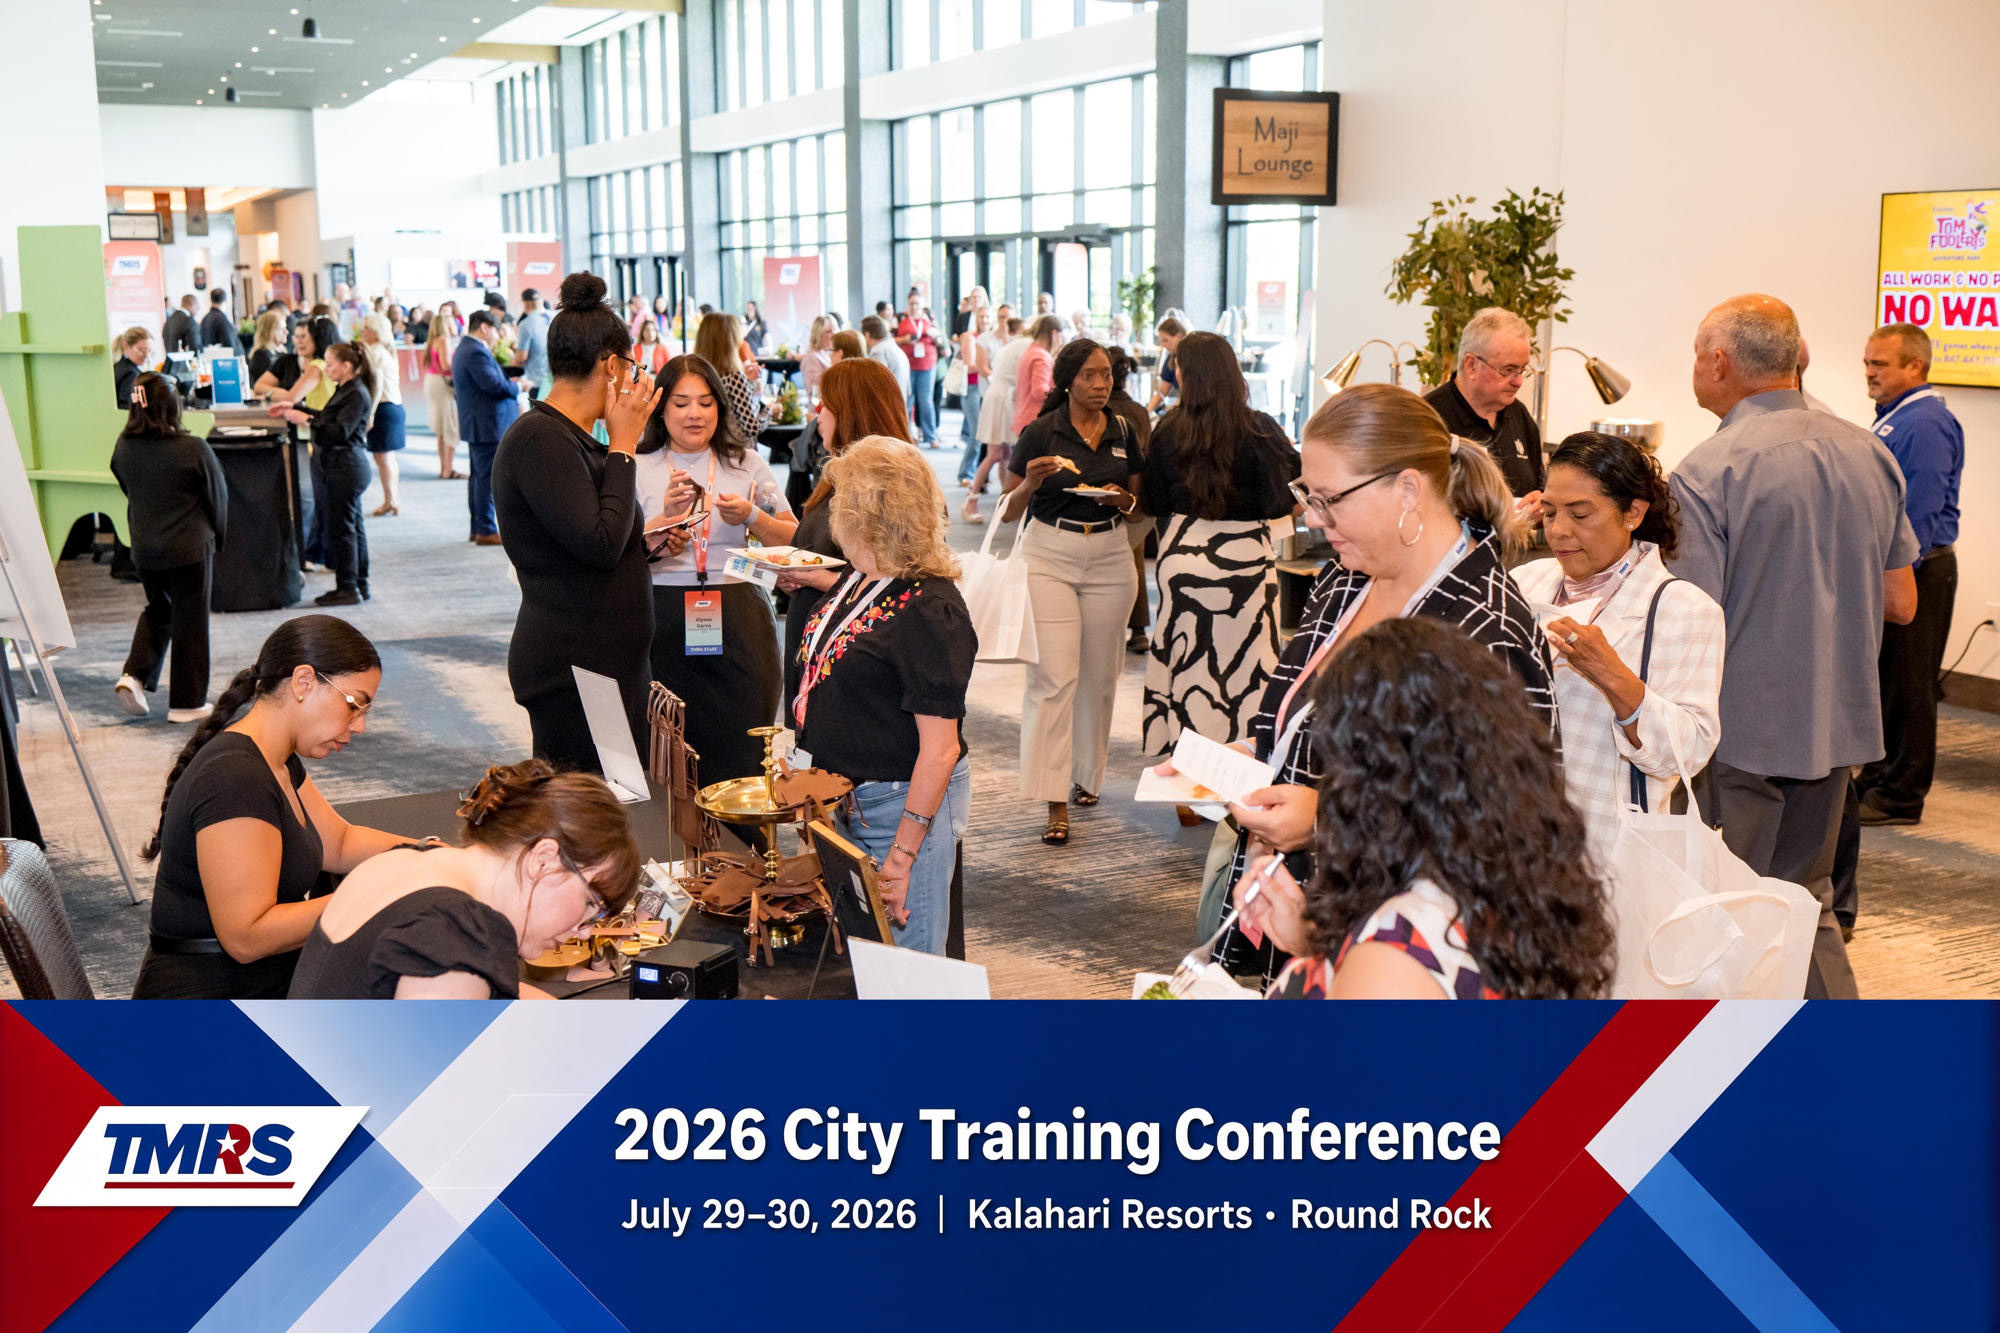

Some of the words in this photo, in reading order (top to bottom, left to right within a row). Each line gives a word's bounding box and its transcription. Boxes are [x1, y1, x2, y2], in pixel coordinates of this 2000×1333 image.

[1254, 116, 1299, 153] Maji
[1238, 147, 1313, 181] Lounge
[1937, 217, 1965, 234] TOM
[1884, 274, 1905, 285] ALL
[1910, 273, 1951, 285] WORK
[1968, 273, 1989, 286] NO
[1884, 294, 1931, 326] NO
[1942, 296, 1999, 327] WA
